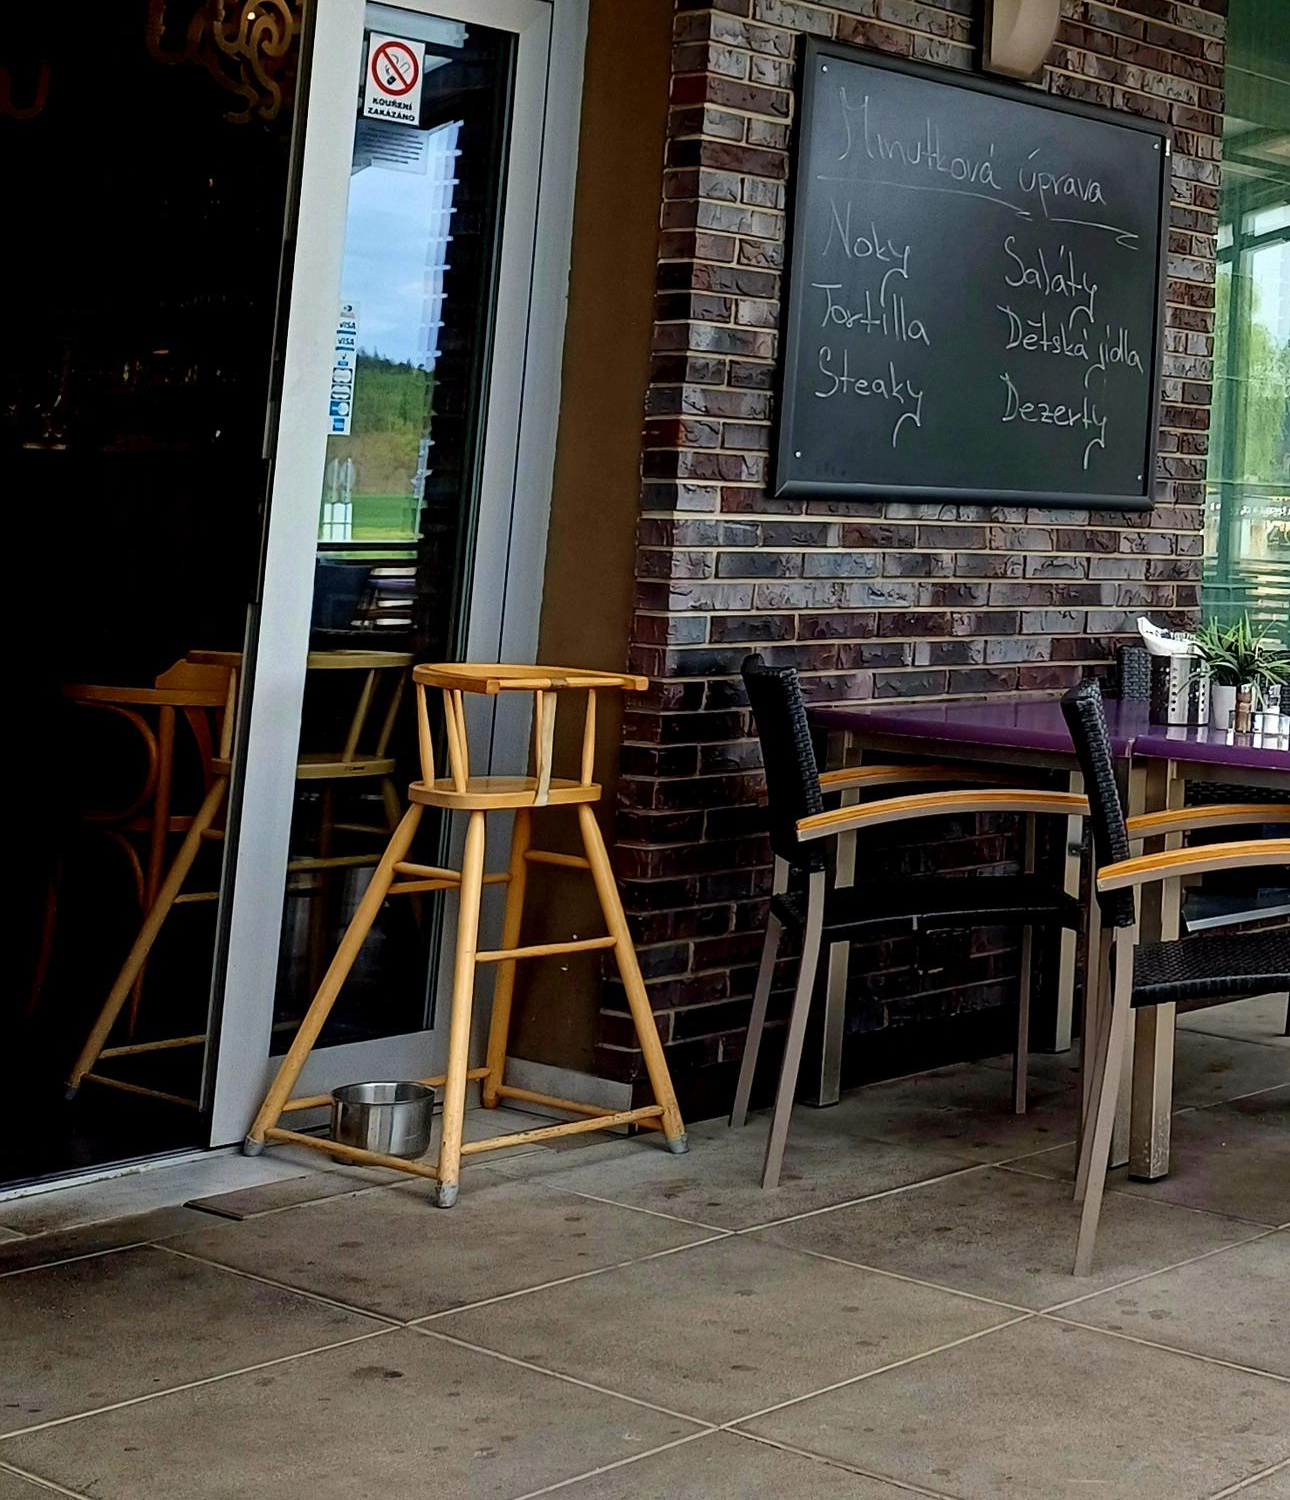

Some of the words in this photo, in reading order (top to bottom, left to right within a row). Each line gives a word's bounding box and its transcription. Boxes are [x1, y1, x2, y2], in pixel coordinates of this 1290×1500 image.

[1018, 147, 1107, 220] úprava
[822, 199, 911, 308] Noky
[1004, 235, 1098, 331] Saláty
[811, 282, 931, 346] Tortilla
[996, 304, 1090, 361] Dětská
[1084, 324, 1144, 389] jídla
[814, 345, 924, 448] Steaky
[999, 372, 1108, 470] Dezerty
